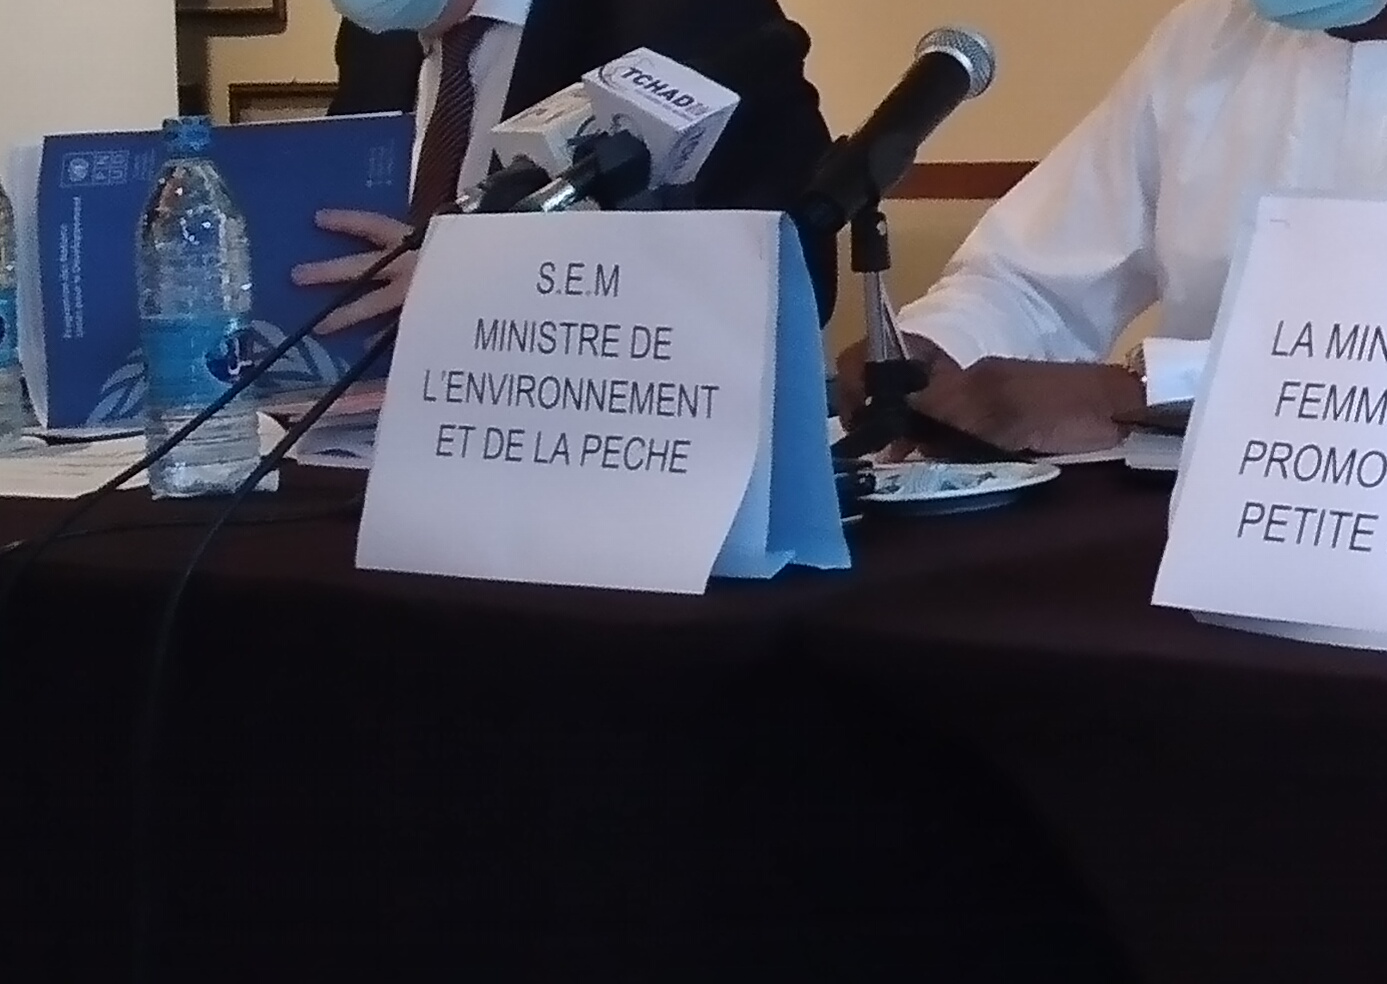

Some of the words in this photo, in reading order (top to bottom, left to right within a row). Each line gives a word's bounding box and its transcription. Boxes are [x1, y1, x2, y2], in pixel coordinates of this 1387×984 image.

[536, 261, 620, 298] S.E.M
[474, 317, 622, 358] MINISTRE
[629, 324, 674, 361] DE
[1270, 319, 1314, 358] LA
[422, 369, 720, 419] L'ENVIRONNEMENT
[435, 423, 477, 459] ET
[482, 426, 526, 463] DE
[533, 430, 571, 466] LA
[579, 433, 692, 475] PECHE
[1236, 501, 1380, 553] PETITE
